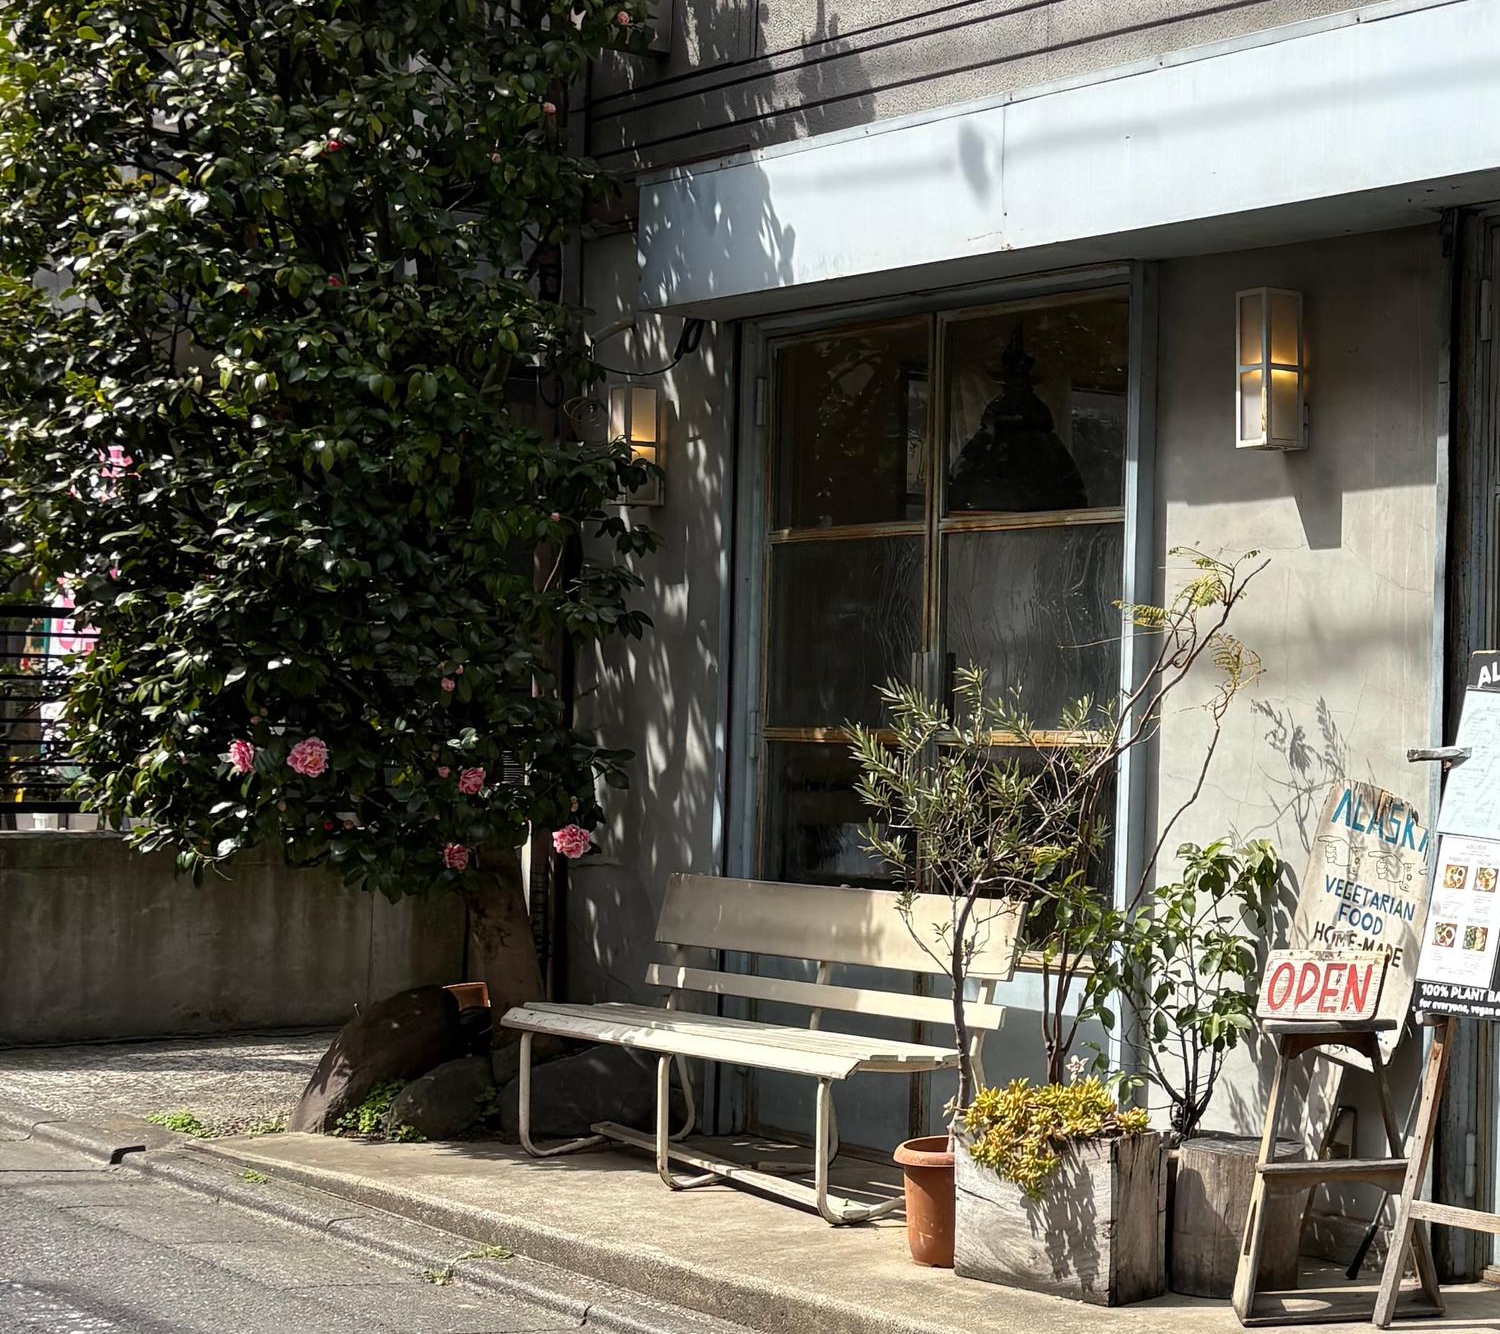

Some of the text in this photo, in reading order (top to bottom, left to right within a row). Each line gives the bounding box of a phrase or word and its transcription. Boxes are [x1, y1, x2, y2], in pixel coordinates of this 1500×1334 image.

[1325, 874, 1415, 921] VEGETARIAN
[1338, 902, 1383, 935] FOOD
[1267, 962, 1373, 1014] OPEN
[1421, 983, 1449, 998] 100%
[1450, 986, 1486, 1001] PLANT
[1419, 998, 1432, 1008] for
[1470, 1005, 1494, 1017] vegan
